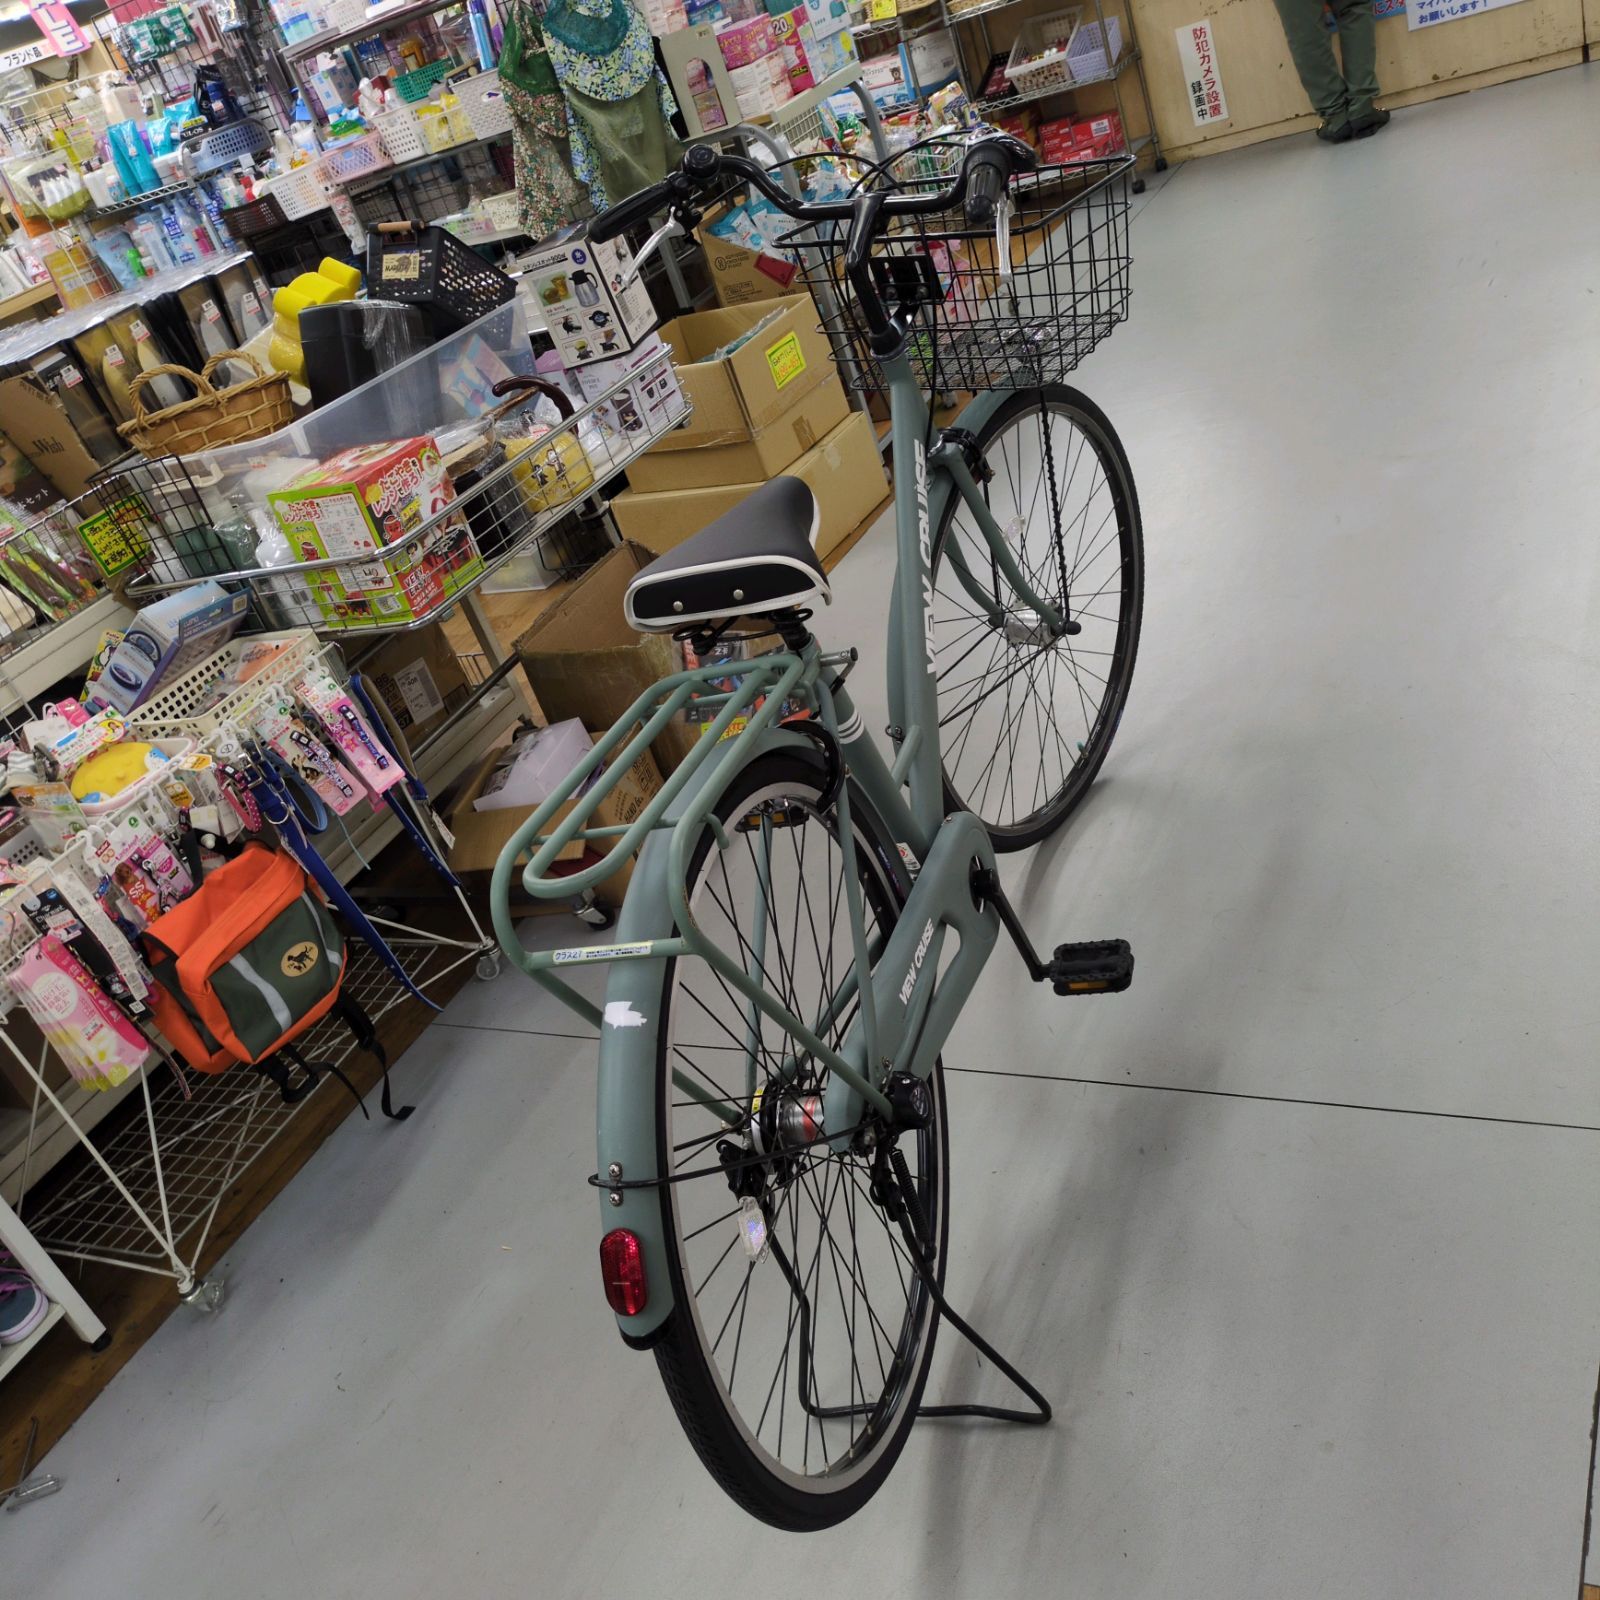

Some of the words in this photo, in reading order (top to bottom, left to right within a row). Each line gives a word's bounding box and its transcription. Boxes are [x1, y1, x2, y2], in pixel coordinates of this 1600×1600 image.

[1190, 80, 1208, 120] 録画中
[1192, 26, 1223, 118] 防犯カメラ設置
[32, 436, 65, 454] Wish
[913, 438, 932, 570] CRUISE
[921, 574, 938, 675] VIEW
[899, 962, 917, 1005] VIEW
[915, 918, 935, 969] CRUISE
